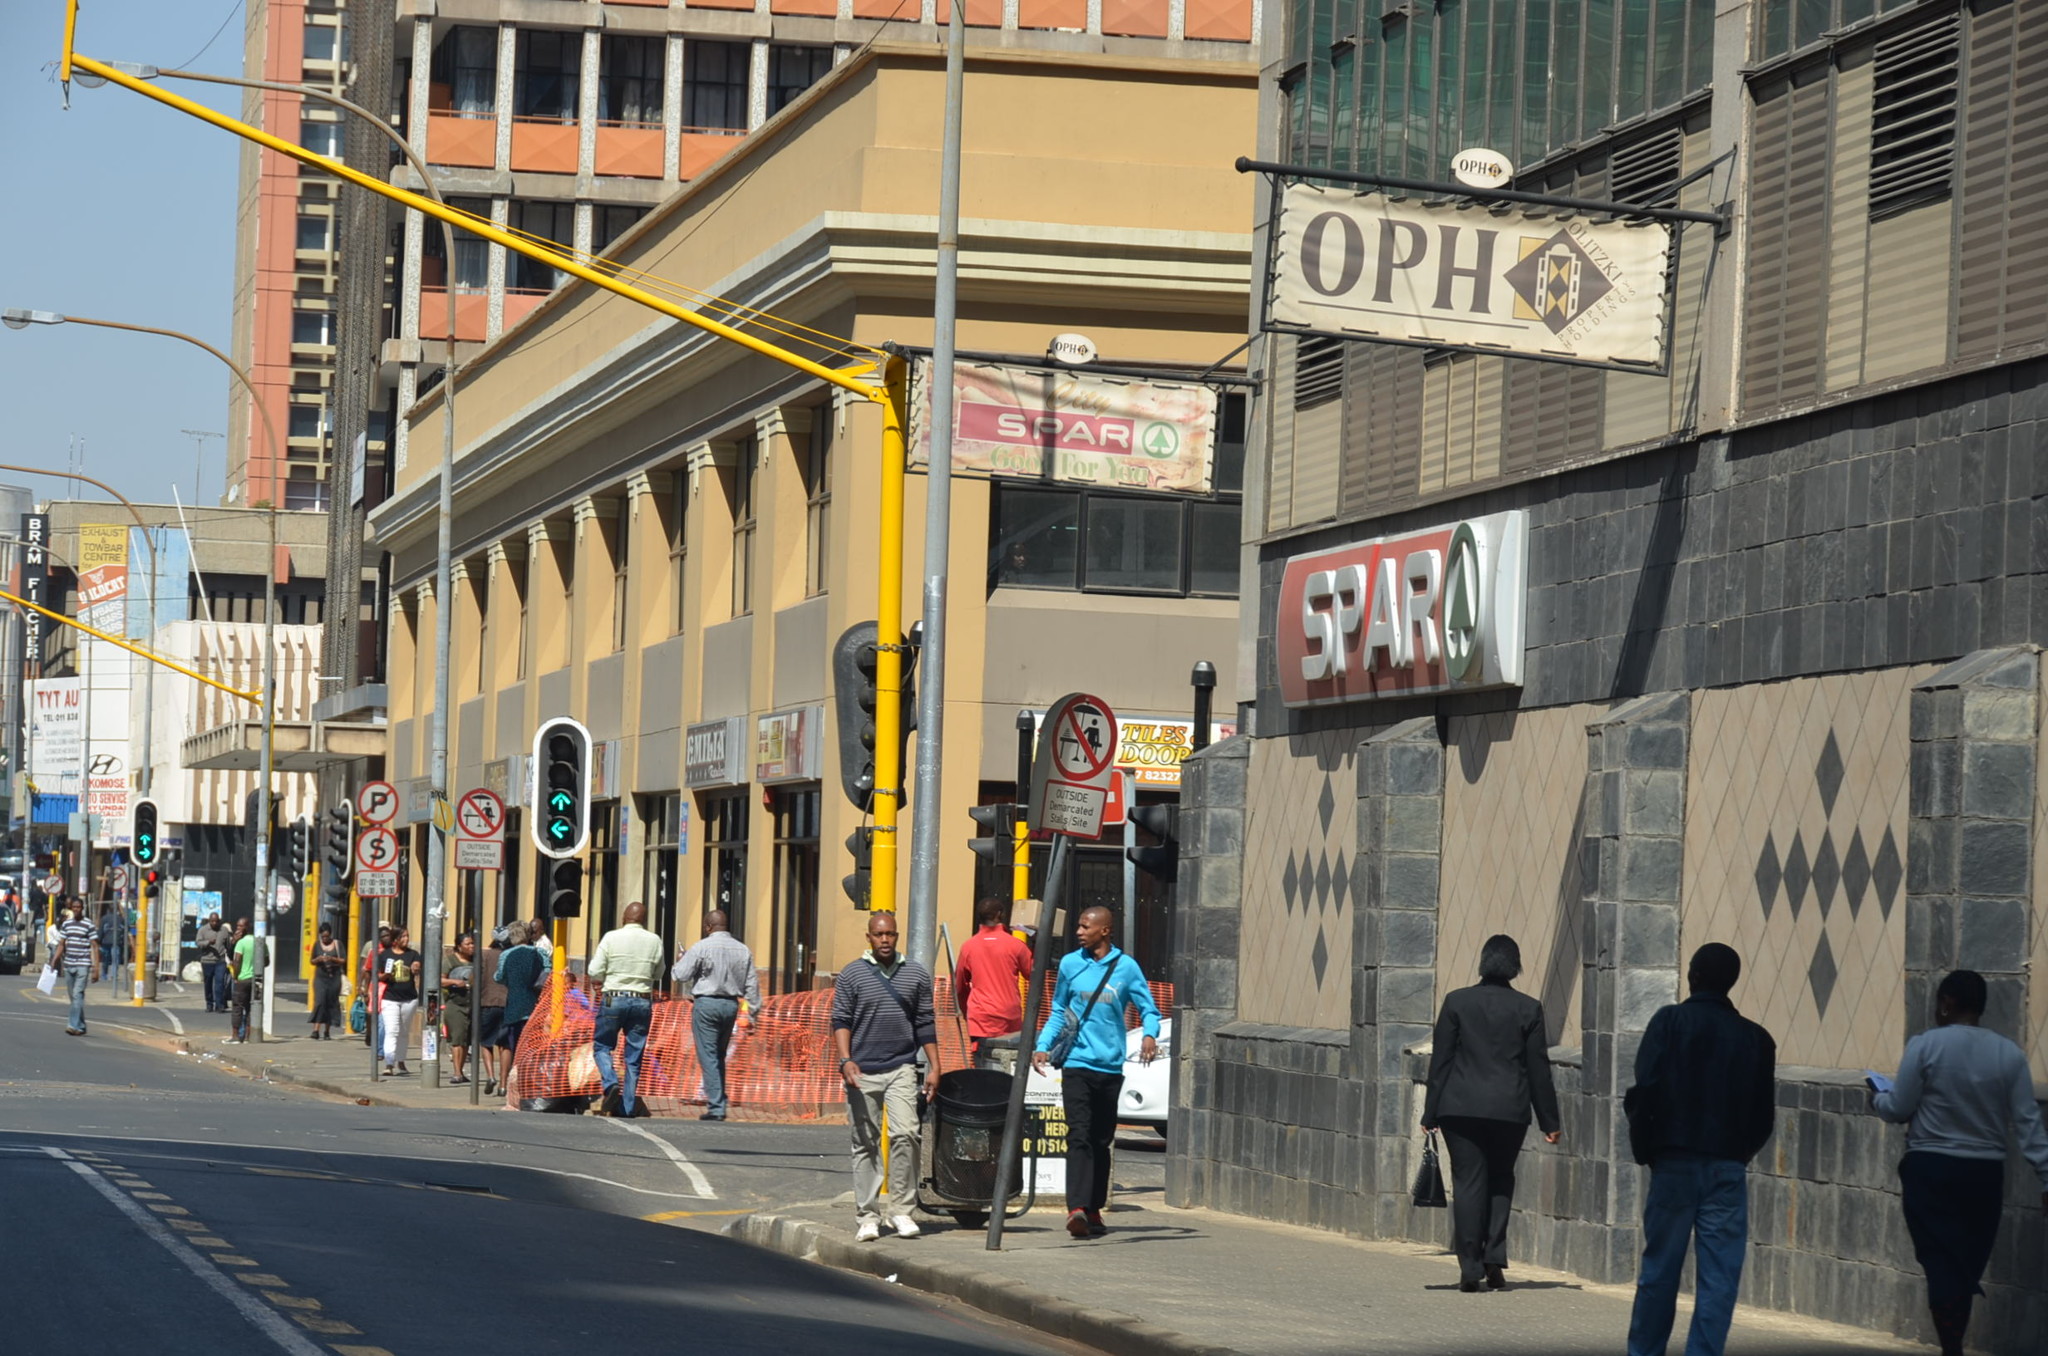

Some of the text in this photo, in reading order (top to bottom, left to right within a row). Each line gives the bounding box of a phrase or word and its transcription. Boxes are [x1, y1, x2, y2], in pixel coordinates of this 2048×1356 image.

[1459, 159, 1487, 175] OPH
[1568, 221, 1623, 282] OLITZKI
[1300, 211, 1499, 315] OPH
[1557, 281, 1630, 342] PROPERTY
[1563, 288, 1636, 350] HOLDINGS
[1055, 341, 1077, 354] OPH
[997, 413, 1130, 448] SPAR
[1062, 453, 1099, 477] For
[1105, 457, 1148, 483] You
[26, 518, 42, 564] BRAM
[81, 528, 125, 537] EXHAUST
[83, 553, 121, 562] CENTRE
[84, 543, 123, 552] TOWBAR
[1302, 549, 1441, 681] SPAR
[37, 690, 60, 709] TYT
[1121, 723, 1187, 745] TILES
[1118, 743, 1194, 765] DOOR
[1144, 770, 1181, 782] 82327
[79, 791, 127, 804] ATO SERVICE
[371, 792, 388, 814] P
[1056, 789, 1088, 803] OUTSIDE
[1049, 800, 1094, 816] Demarcated
[369, 838, 387, 860] S
